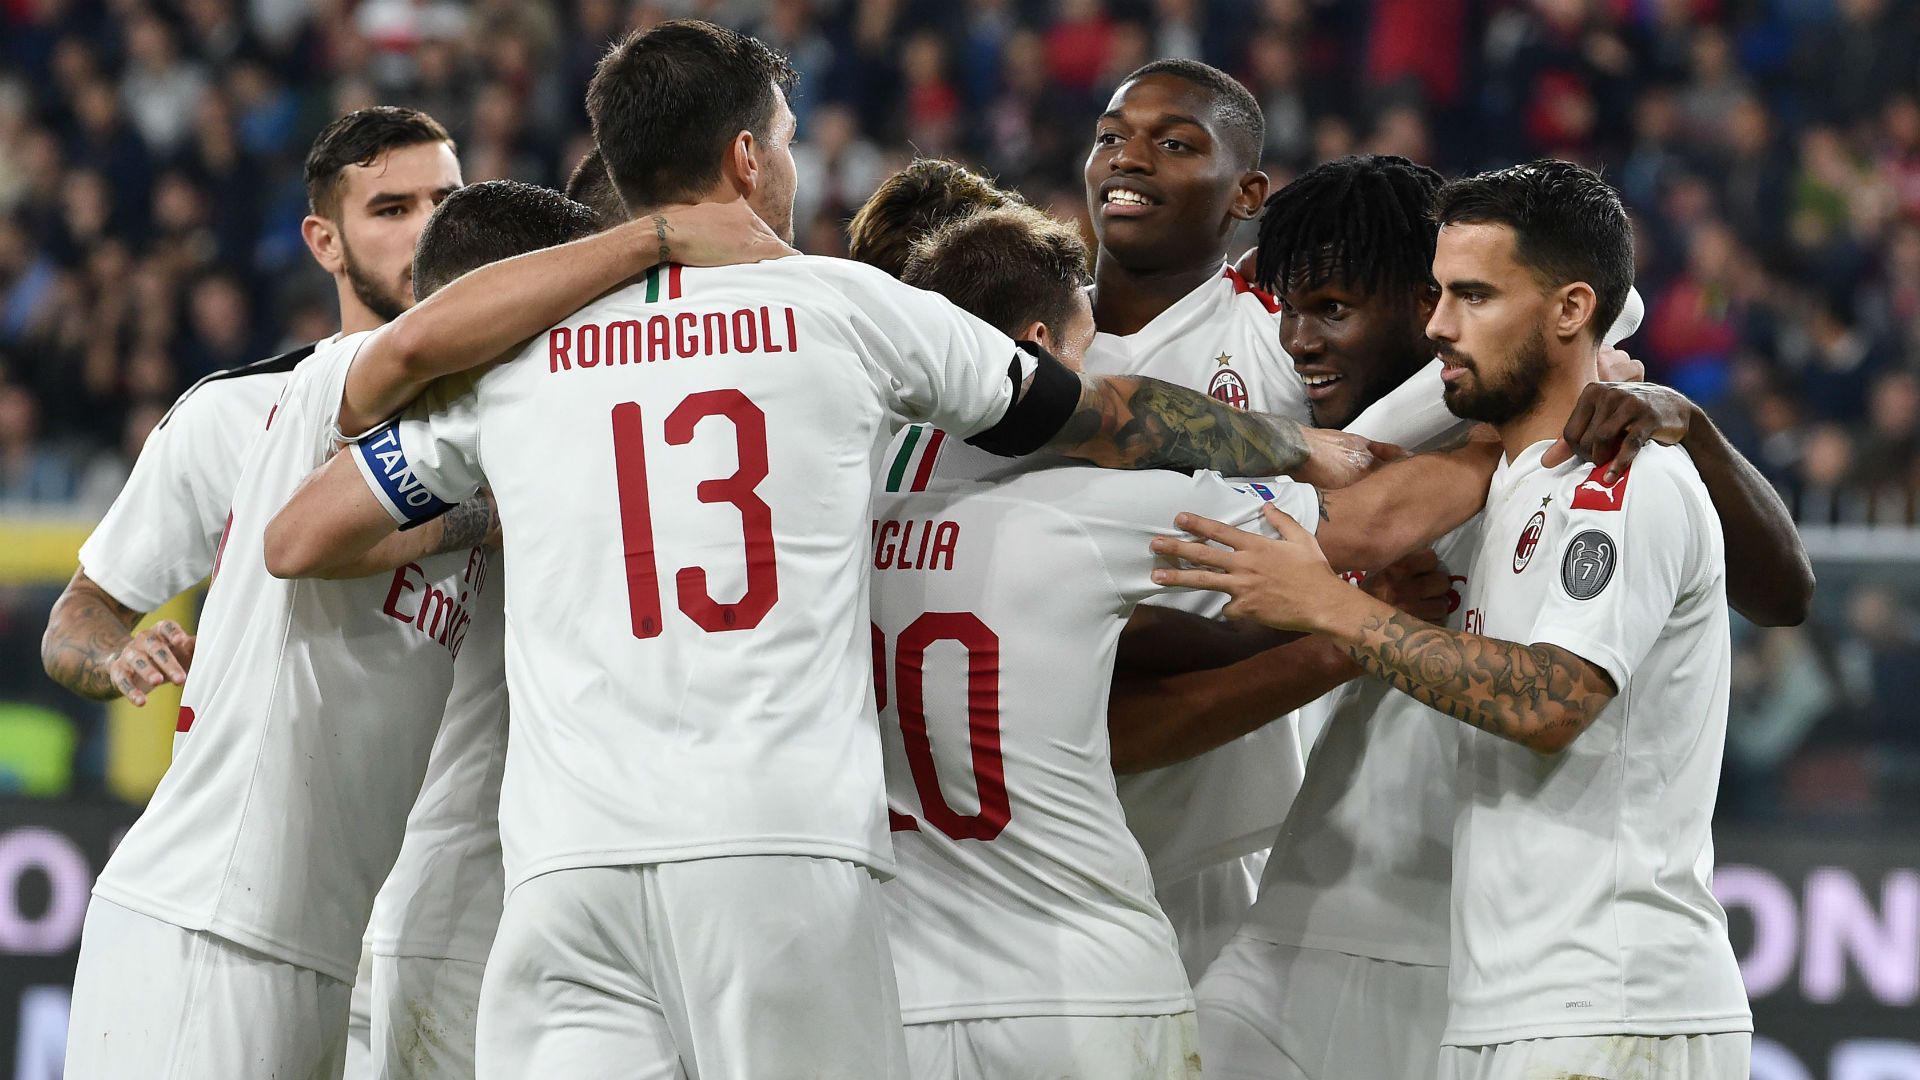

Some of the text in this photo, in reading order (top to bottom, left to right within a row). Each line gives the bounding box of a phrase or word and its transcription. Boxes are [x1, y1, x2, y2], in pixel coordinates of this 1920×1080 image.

[549, 306, 797, 373] ROMAGNOLI
[611, 388, 779, 640] 13
[1581, 563, 1593, 580] 7
